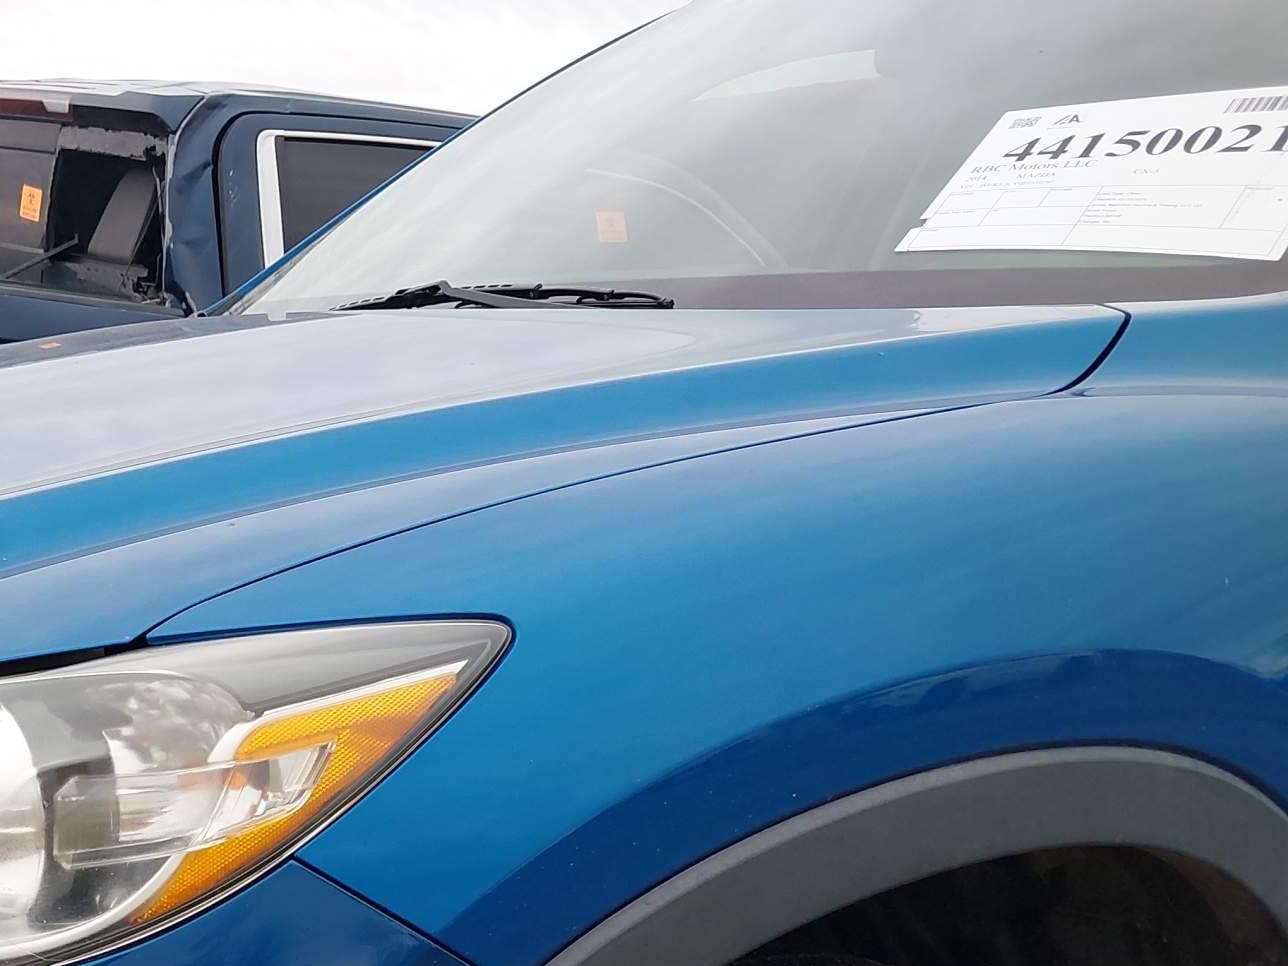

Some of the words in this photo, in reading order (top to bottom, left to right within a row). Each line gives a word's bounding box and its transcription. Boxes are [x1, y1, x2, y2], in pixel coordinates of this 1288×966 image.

[1002, 124, 1288, 162] 44150021
[970, 164, 1007, 174] RBC
[1008, 162, 1060, 171] Motors
[1063, 159, 1099, 168] LLC
